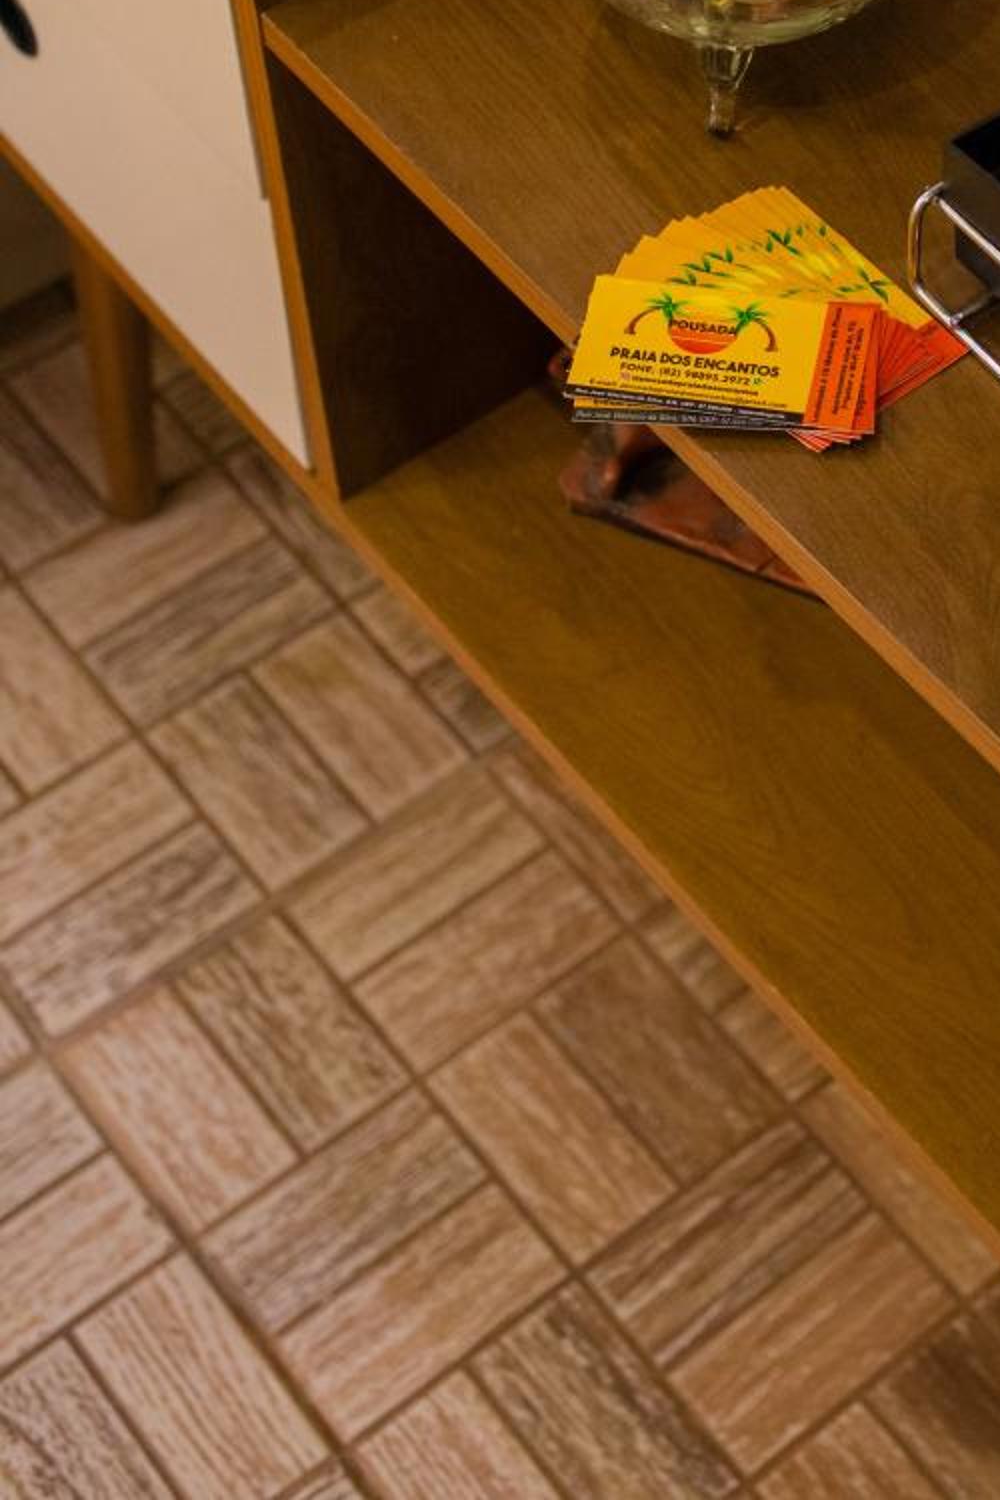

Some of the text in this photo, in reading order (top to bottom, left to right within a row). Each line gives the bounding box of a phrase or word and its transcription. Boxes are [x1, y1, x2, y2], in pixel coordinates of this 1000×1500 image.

[671, 318, 737, 336] POUSADA
[610, 346, 780, 377] PRAIA DOS ENCANTOS
